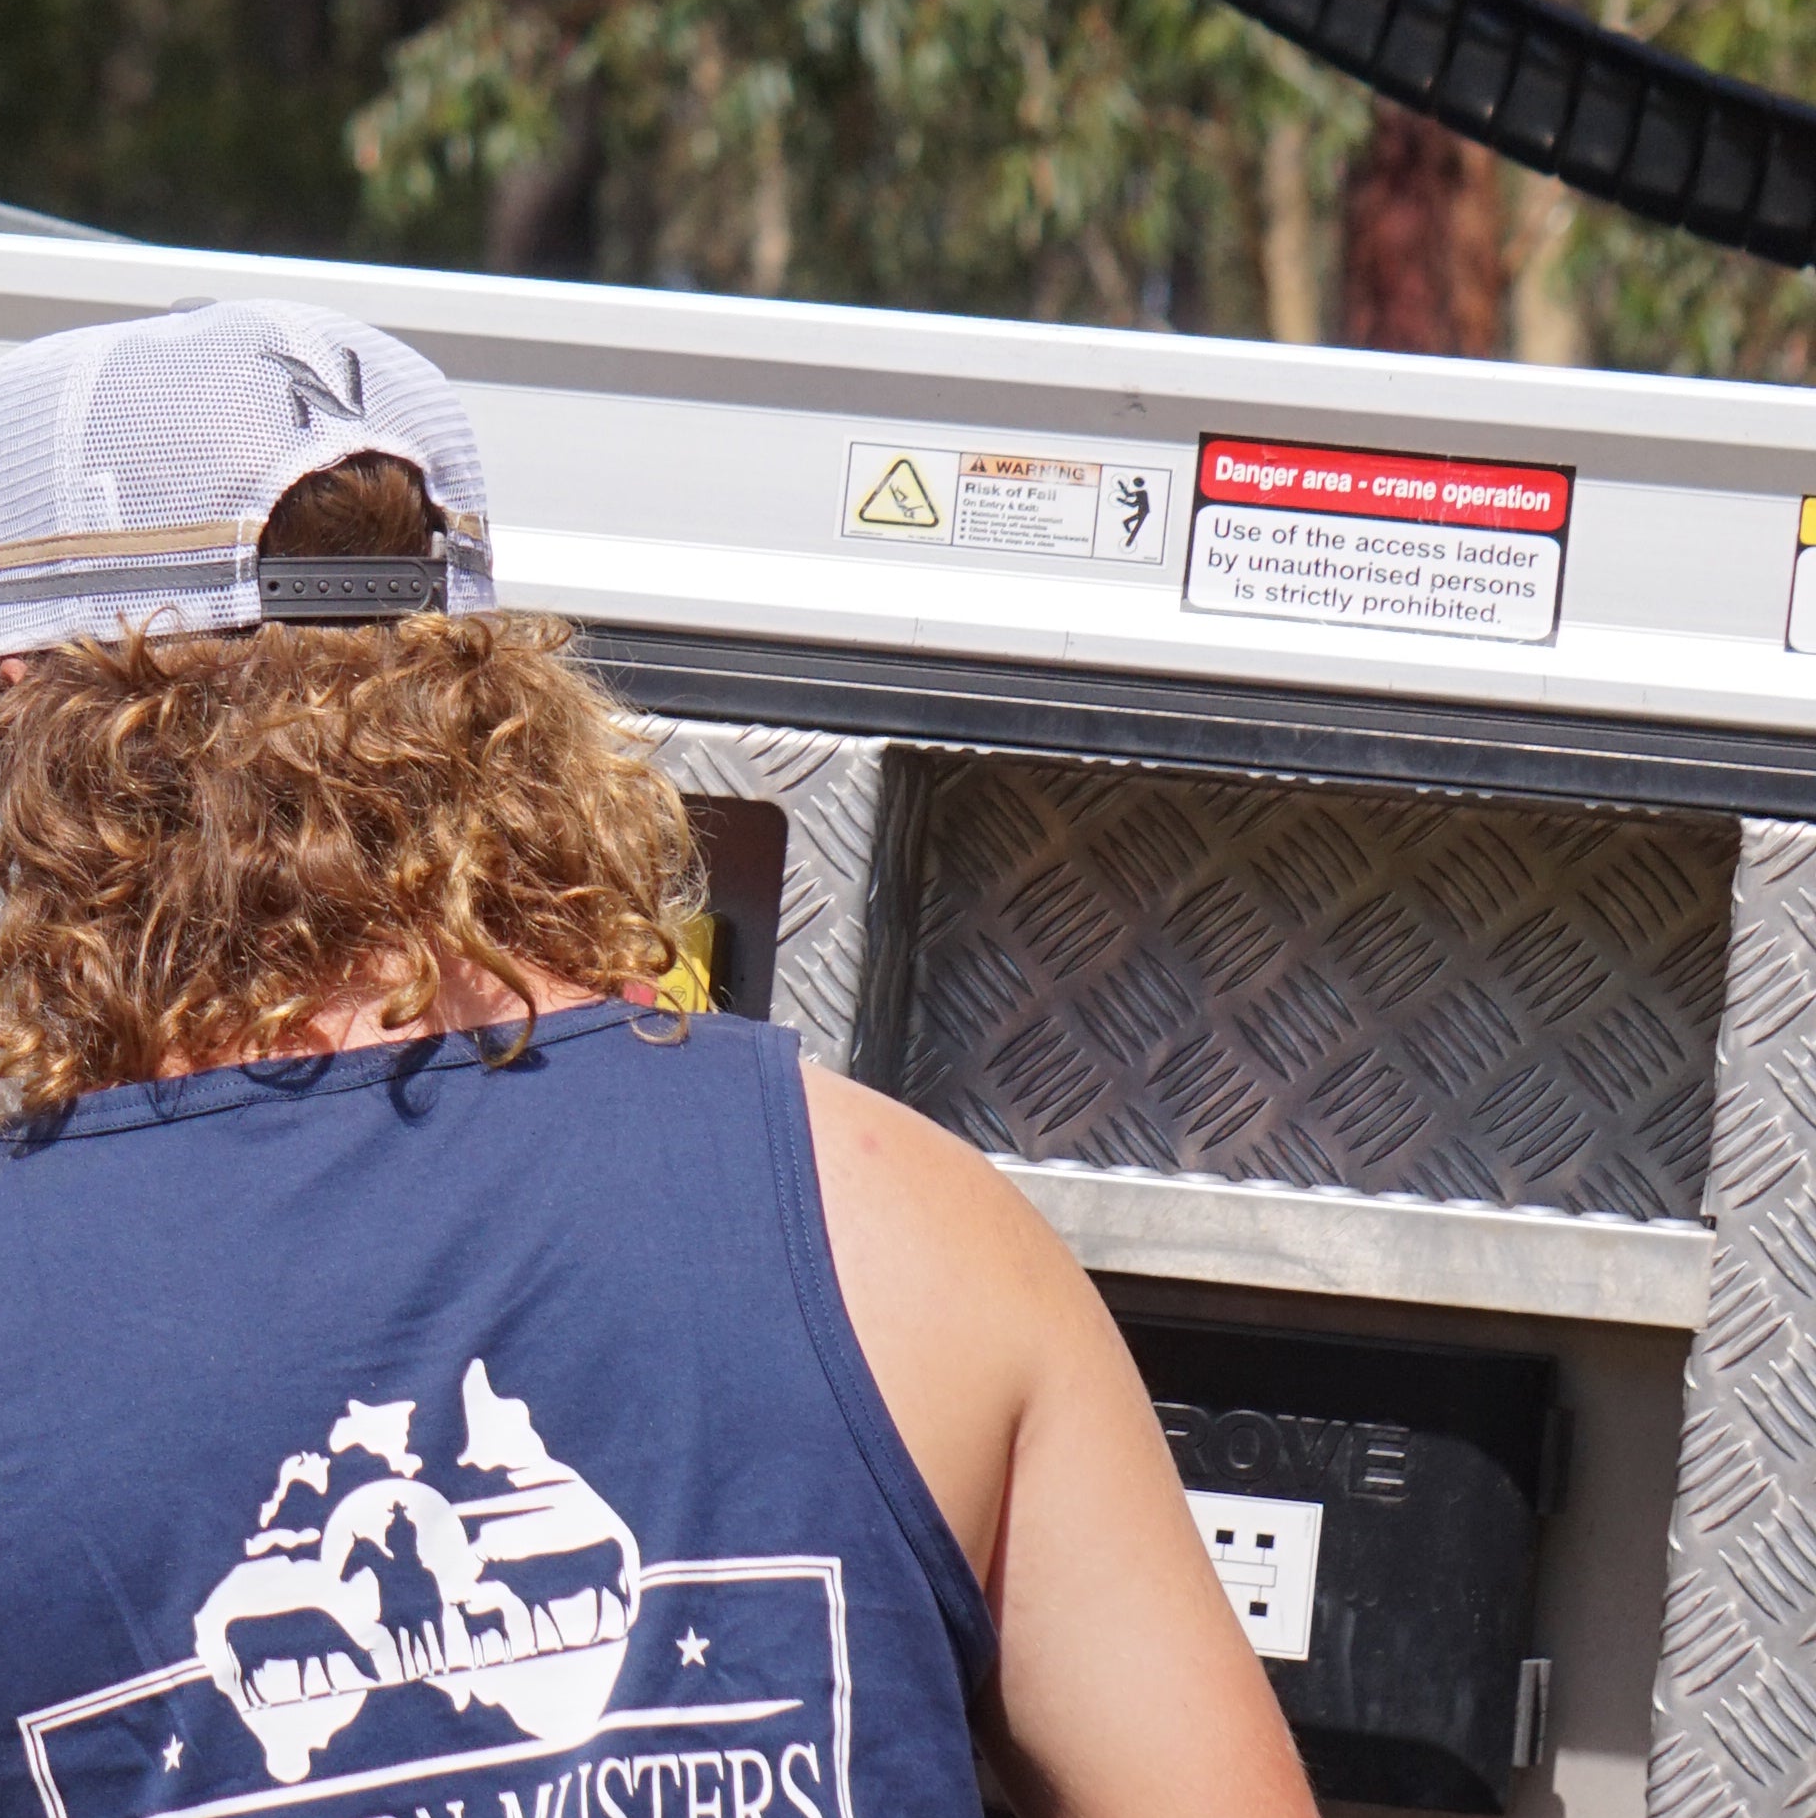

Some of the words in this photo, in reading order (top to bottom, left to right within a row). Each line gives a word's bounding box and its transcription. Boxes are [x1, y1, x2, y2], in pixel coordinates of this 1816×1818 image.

[964, 482, 1000, 496] Risk
[1006, 486, 1022, 498] of
[979, 500, 1005, 512] Entry
[1215, 456, 1298, 491] Danger
[1302, 470, 1352, 493] area
[1372, 475, 1437, 502] crane
[1442, 480, 1551, 512] operation
[1213, 518, 1262, 543] Use
[1271, 524, 1298, 546] of
[1306, 527, 1346, 551] the
[1355, 535, 1446, 560] access
[1456, 541, 1540, 569] ladder
[1207, 547, 1239, 573] by
[1248, 554, 1422, 587] unauthorised
[1429, 571, 1537, 599] persons
[1234, 578, 1254, 600] is
[1265, 583, 1353, 613] strictly
[1362, 592, 1502, 625] prohibited.
